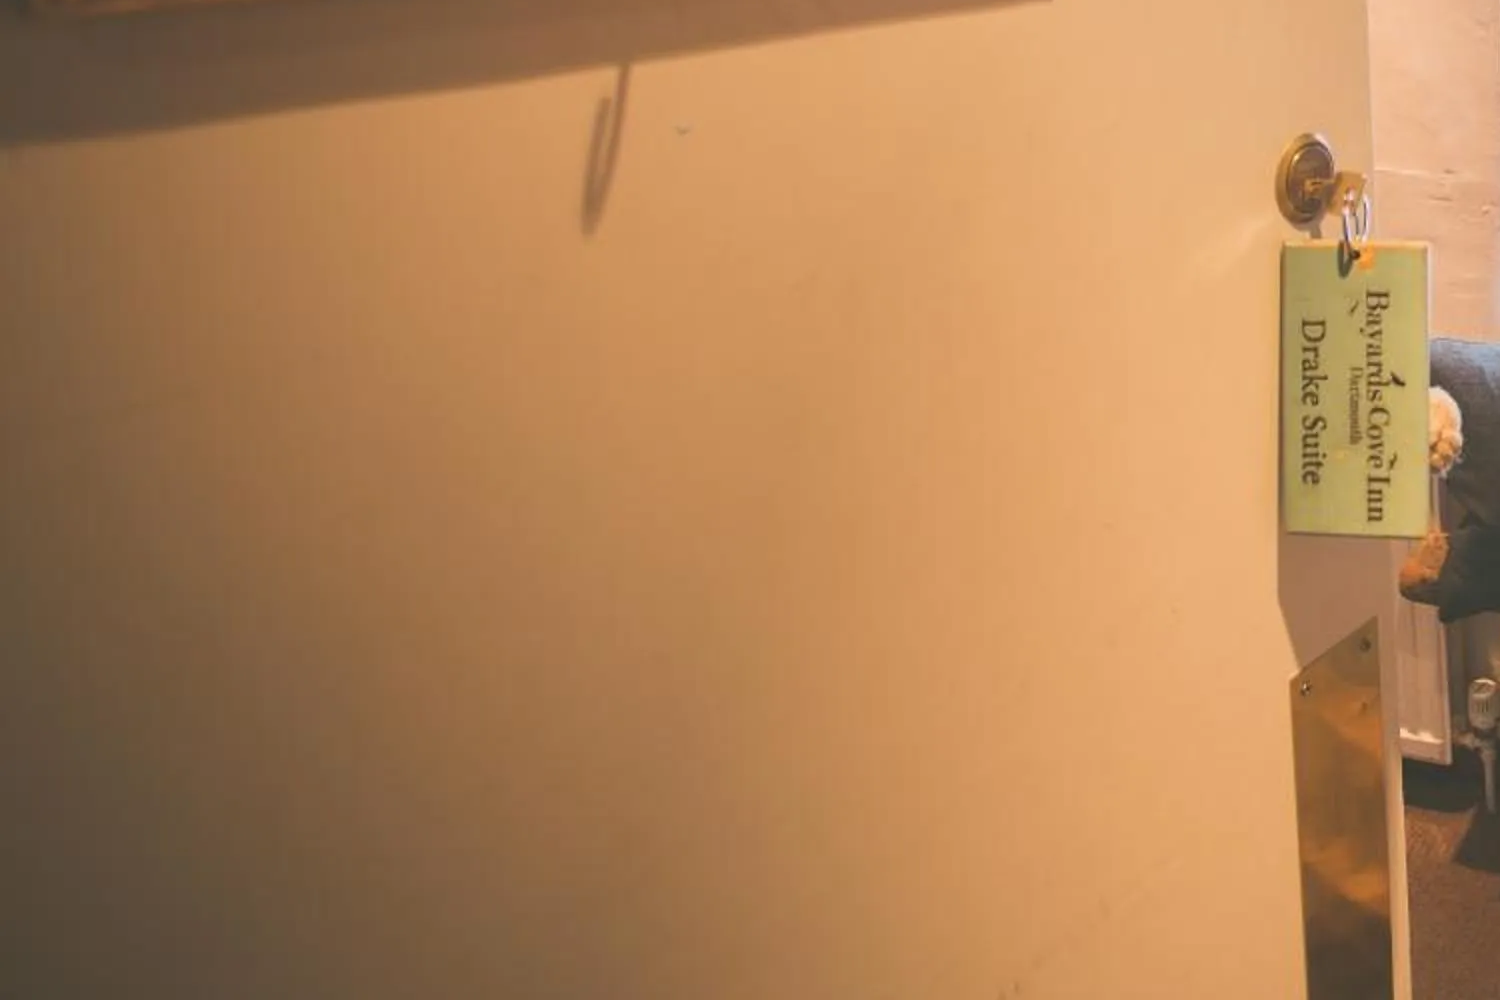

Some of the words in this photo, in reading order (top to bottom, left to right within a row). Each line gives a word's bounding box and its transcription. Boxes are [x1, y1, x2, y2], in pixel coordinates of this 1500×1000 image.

[1301, 319, 1328, 406] Drake
[1360, 289, 1391, 401] Bayards
[1349, 367, 1364, 446] Dartmouth
[1366, 407, 1391, 468] Cove
[1301, 416, 1328, 486] Suite
[1366, 474, 1391, 522] Inn
